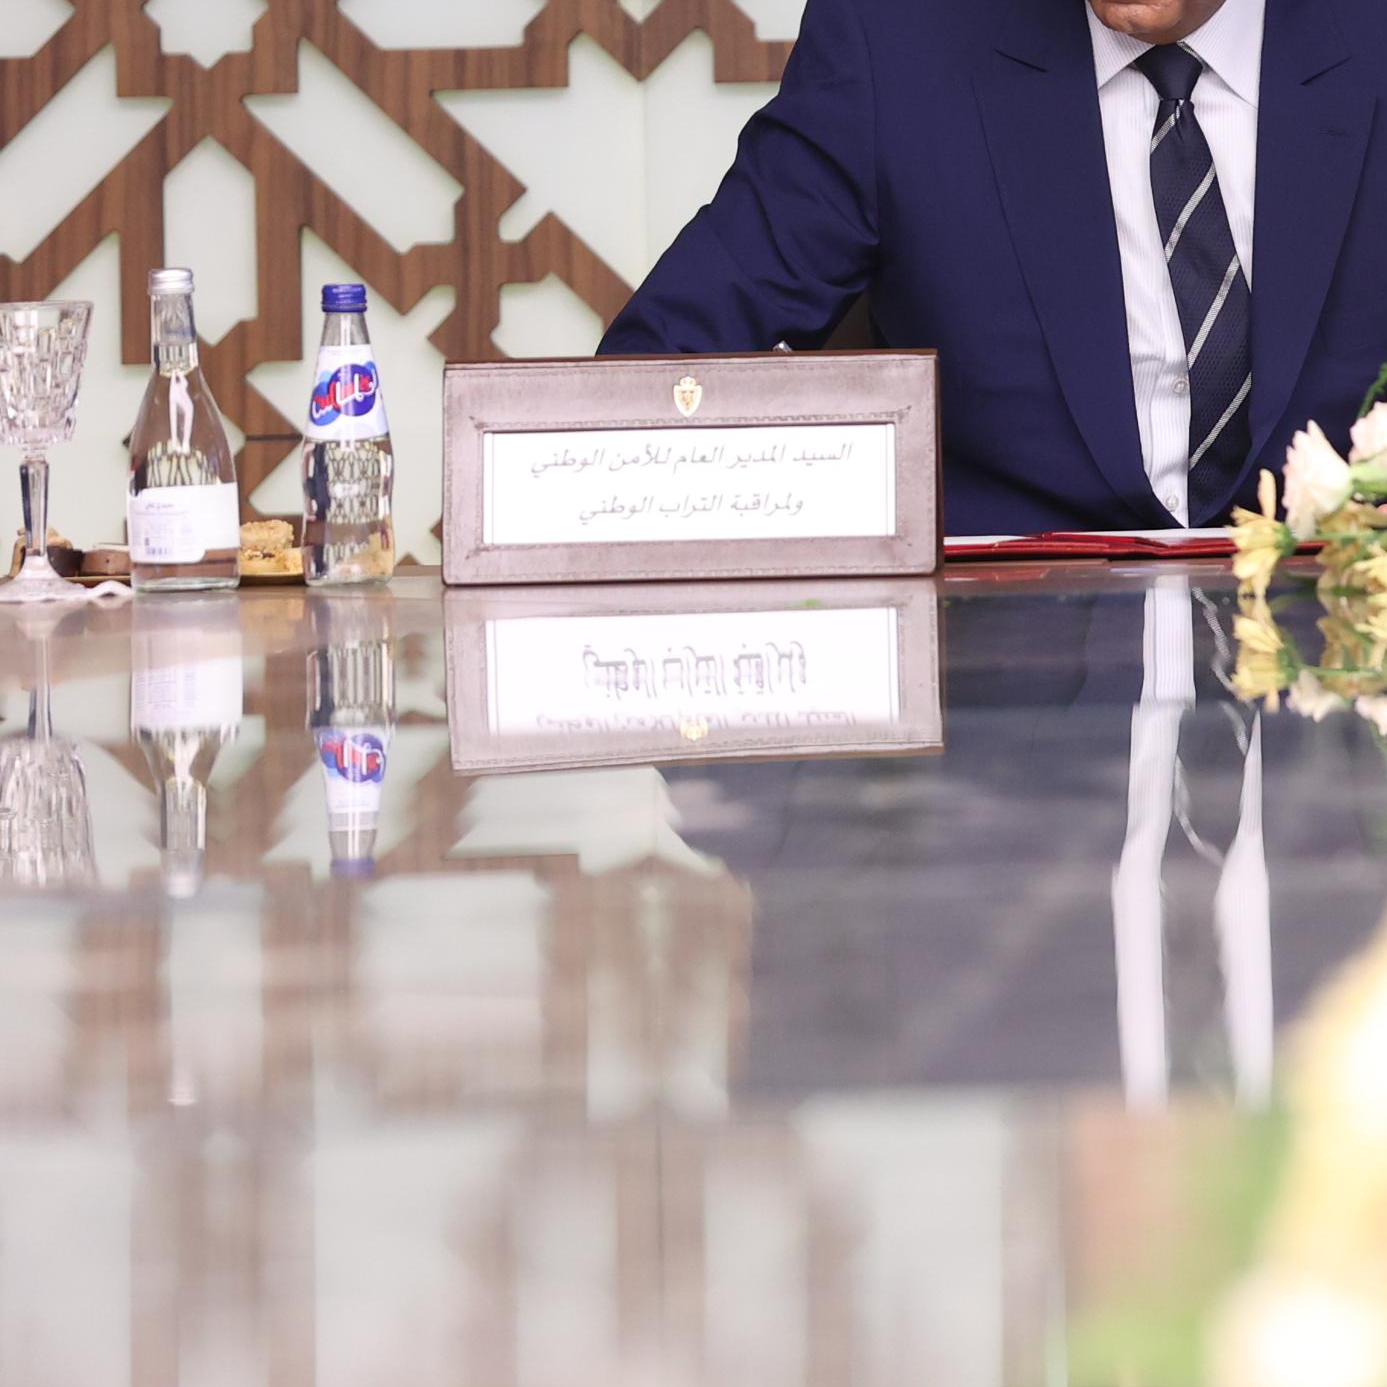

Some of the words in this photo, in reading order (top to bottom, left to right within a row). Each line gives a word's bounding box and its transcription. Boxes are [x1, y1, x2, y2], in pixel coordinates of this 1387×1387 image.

[531, 449, 605, 478] الوطني
[609, 444, 671, 471] للأمن
[674, 446, 724, 472] العام
[729, 445, 785, 468] المدير
[793, 444, 852, 466] السيد
[580, 496, 653, 525] الوطني
[659, 495, 722, 518] التراب
[731, 494, 803, 516] ولمراقبة
